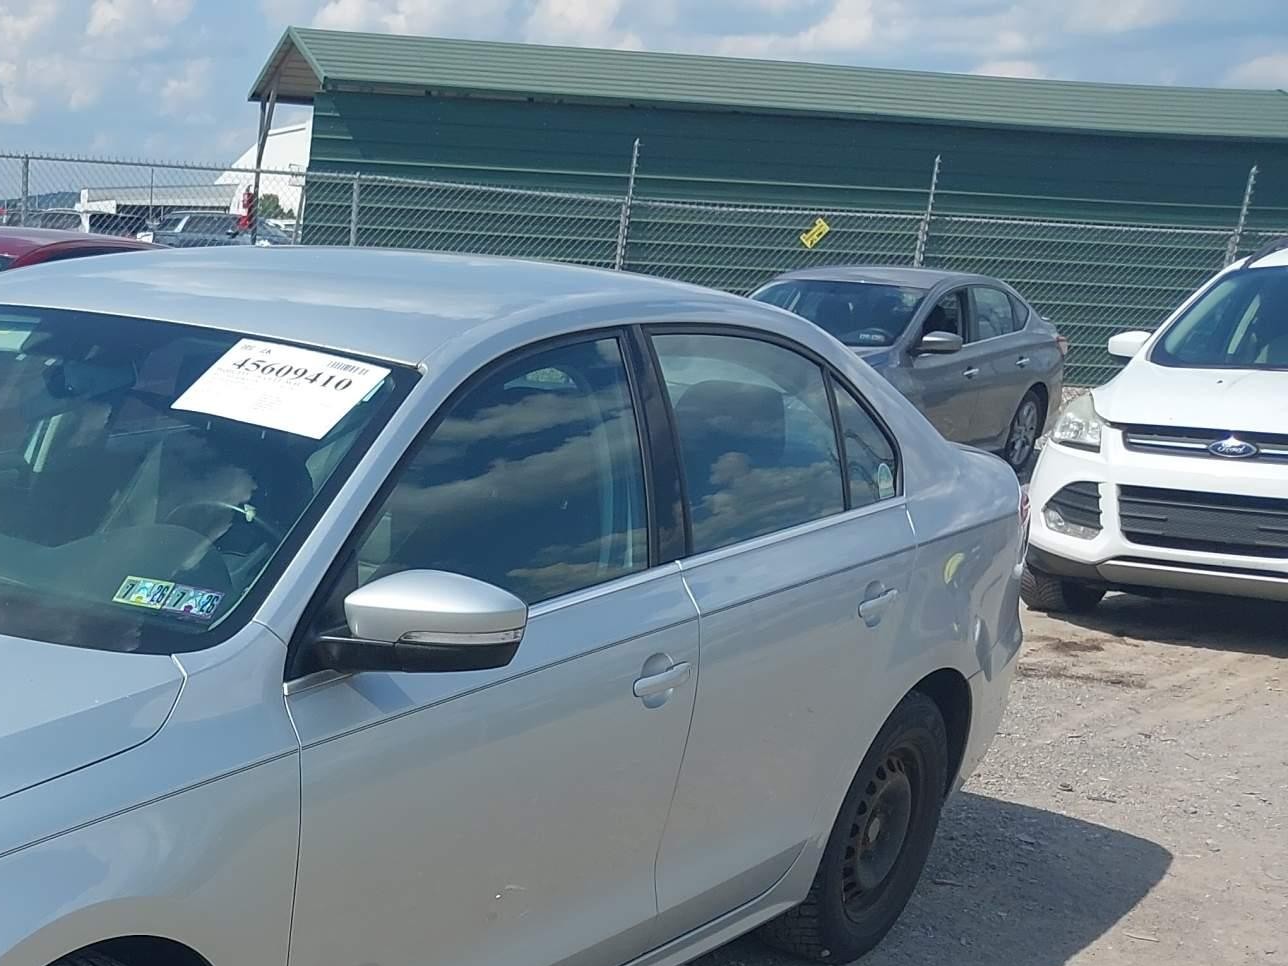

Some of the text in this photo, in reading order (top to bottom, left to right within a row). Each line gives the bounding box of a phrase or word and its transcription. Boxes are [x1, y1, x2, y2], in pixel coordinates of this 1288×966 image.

[232, 356, 353, 392] 45609410
[122, 583, 170, 604] 7 26
[172, 591, 219, 614] 7 26
